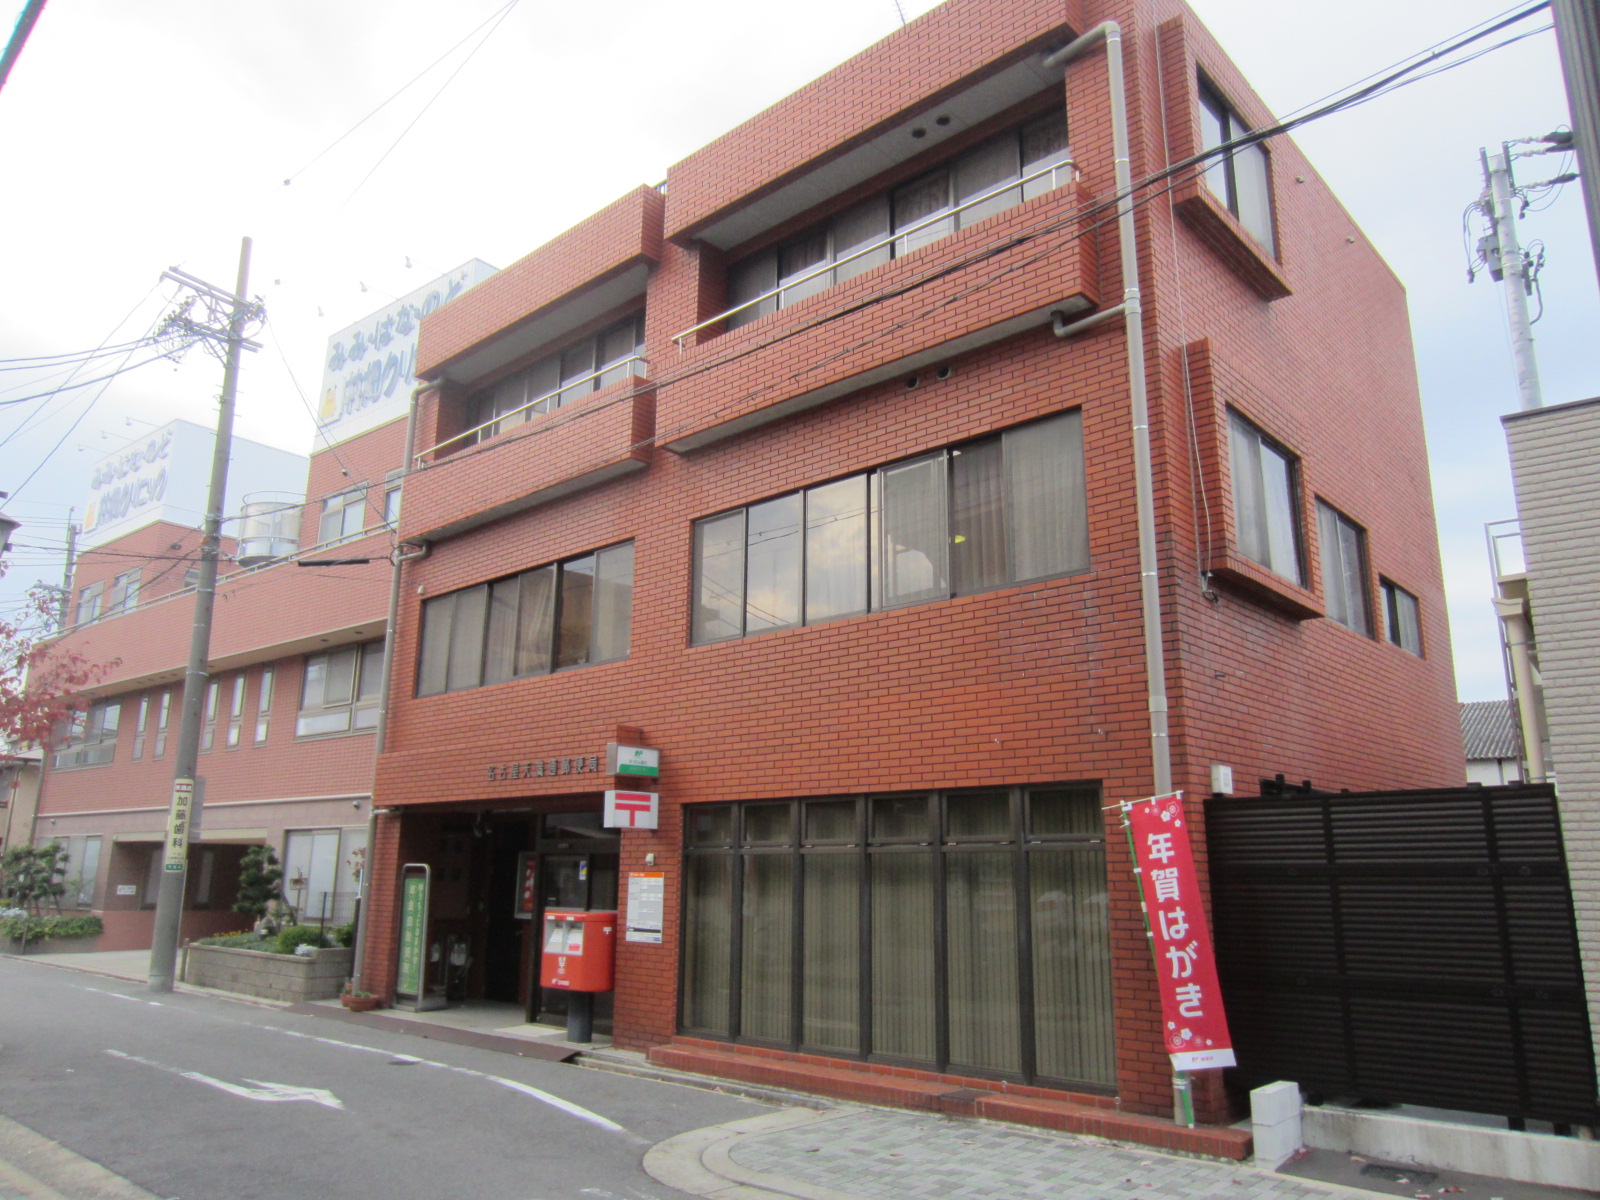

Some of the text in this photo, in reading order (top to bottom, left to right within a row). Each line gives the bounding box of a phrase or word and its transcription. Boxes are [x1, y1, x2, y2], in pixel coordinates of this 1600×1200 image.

[172, 796, 188, 849] 加藤歯科
[1147, 833, 1205, 1018] 年賀はがき
